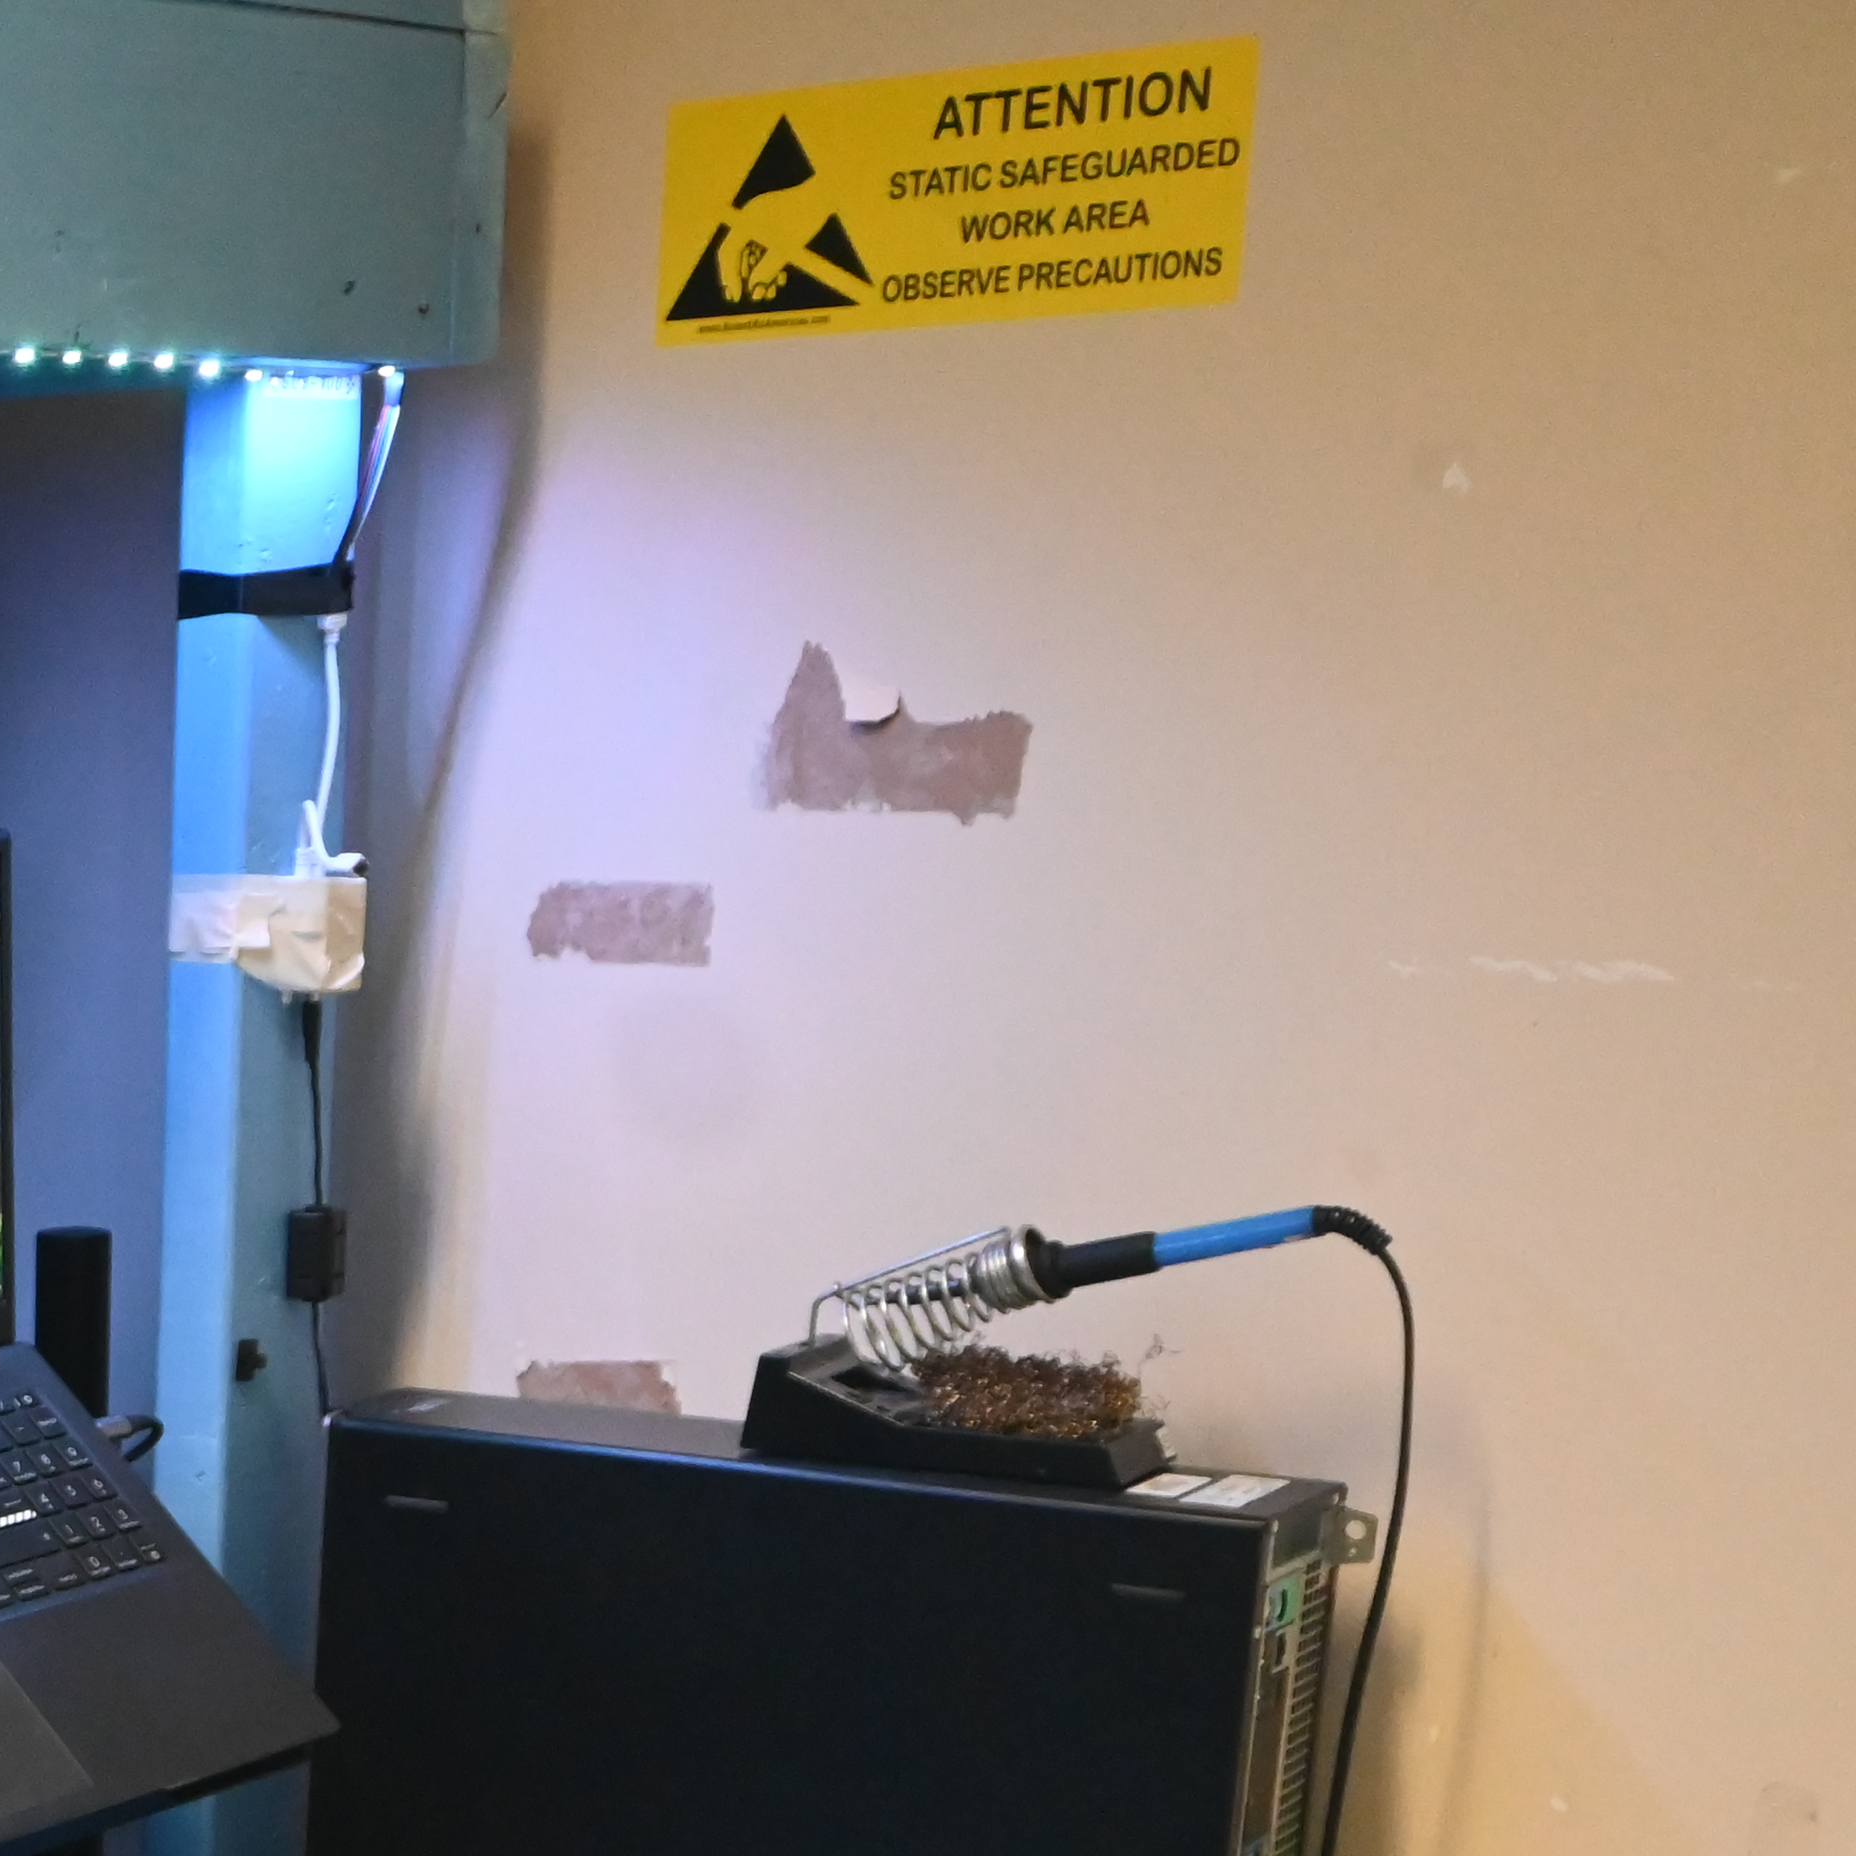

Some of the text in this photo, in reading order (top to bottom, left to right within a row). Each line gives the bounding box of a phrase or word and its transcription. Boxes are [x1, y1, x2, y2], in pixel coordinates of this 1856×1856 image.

[932, 65, 1214, 142] ATTENTION
[889, 136, 1242, 201] STATIC SAFEGUARDED
[960, 198, 1151, 245] WORK AREA
[882, 246, 1224, 304] OBSERVE PRECAUTIONS
